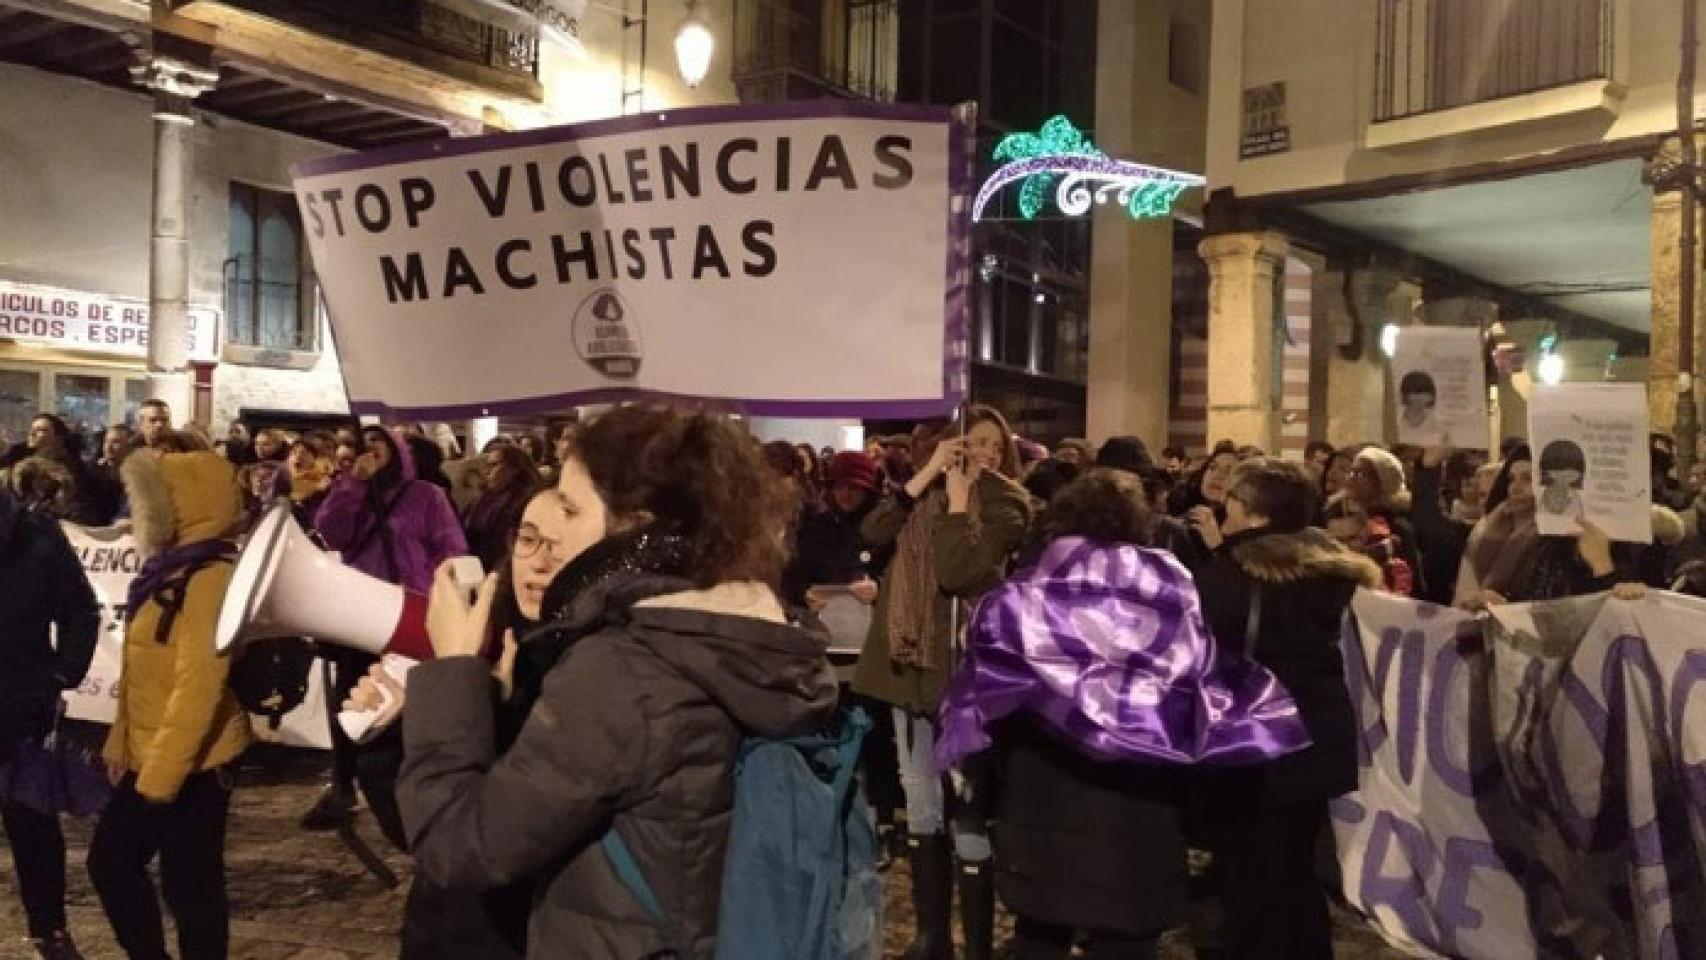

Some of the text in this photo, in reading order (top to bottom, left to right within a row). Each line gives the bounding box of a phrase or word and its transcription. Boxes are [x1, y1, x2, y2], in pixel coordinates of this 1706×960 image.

[306, 134, 913, 239] STOP VIOLENCIAS
[380, 220, 777, 303] MACHISTAS
[0, 293, 79, 318] ICULOS
[88, 303, 114, 322] DE
[0, 315, 65, 339] RCOS
